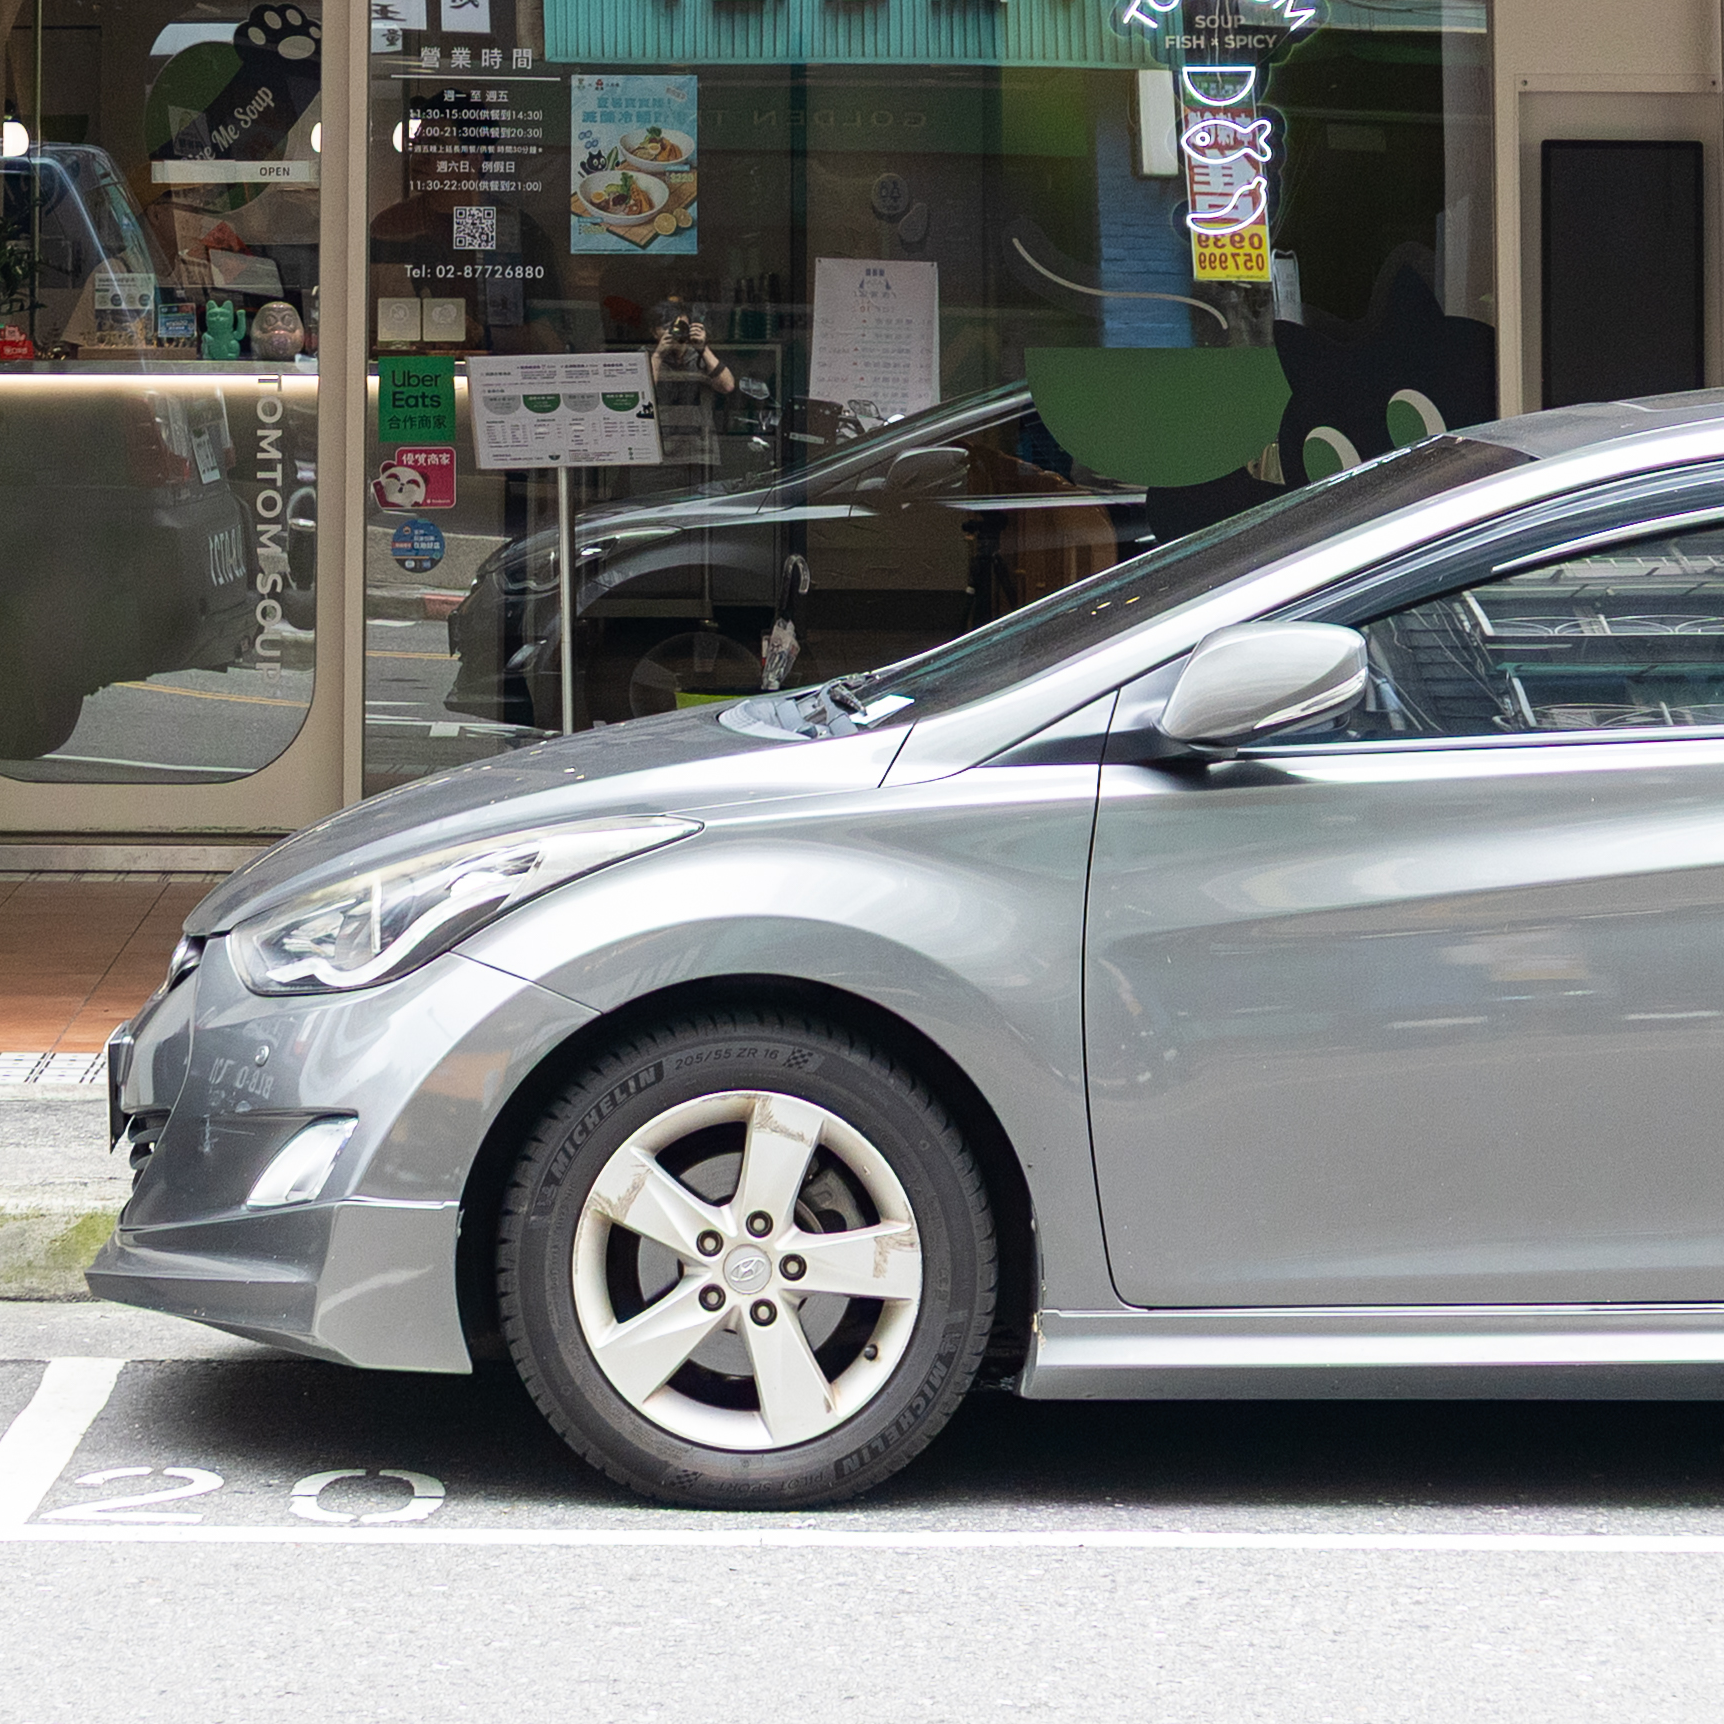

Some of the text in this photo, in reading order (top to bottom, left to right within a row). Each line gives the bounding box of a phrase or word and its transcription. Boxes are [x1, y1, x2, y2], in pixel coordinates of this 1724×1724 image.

[1194, 14, 1247, 29] SOUP
[1165, 34, 1206, 50] FISH
[1224, 33, 1278, 50] SPICY
[420, 46, 533, 70] 營業時間
[443, 89, 510, 103] 週一 至 週五
[211, 124, 241, 153] Me
[233, 86, 276, 129] Soup
[259, 166, 291, 177] OPEN
[409, 179, 543, 192] 11:30-22:00(供餐到21:00)
[404, 263, 545, 279] Tel: 02-87726880
[391, 370, 443, 388] Uber
[391, 390, 442, 409] Eats
[387, 414, 448, 430] 合作商家
[401, 452, 452, 467] 優質商家
[254, 376, 284, 686] TOMTOM SOUP
[673, 1047, 780, 1071] 205/55 ZR 16
[551, 1069, 659, 1177] MICHELIN
[841, 1361, 950, 1475] MICHELIN
[39, 1465, 449, 1525] 20
